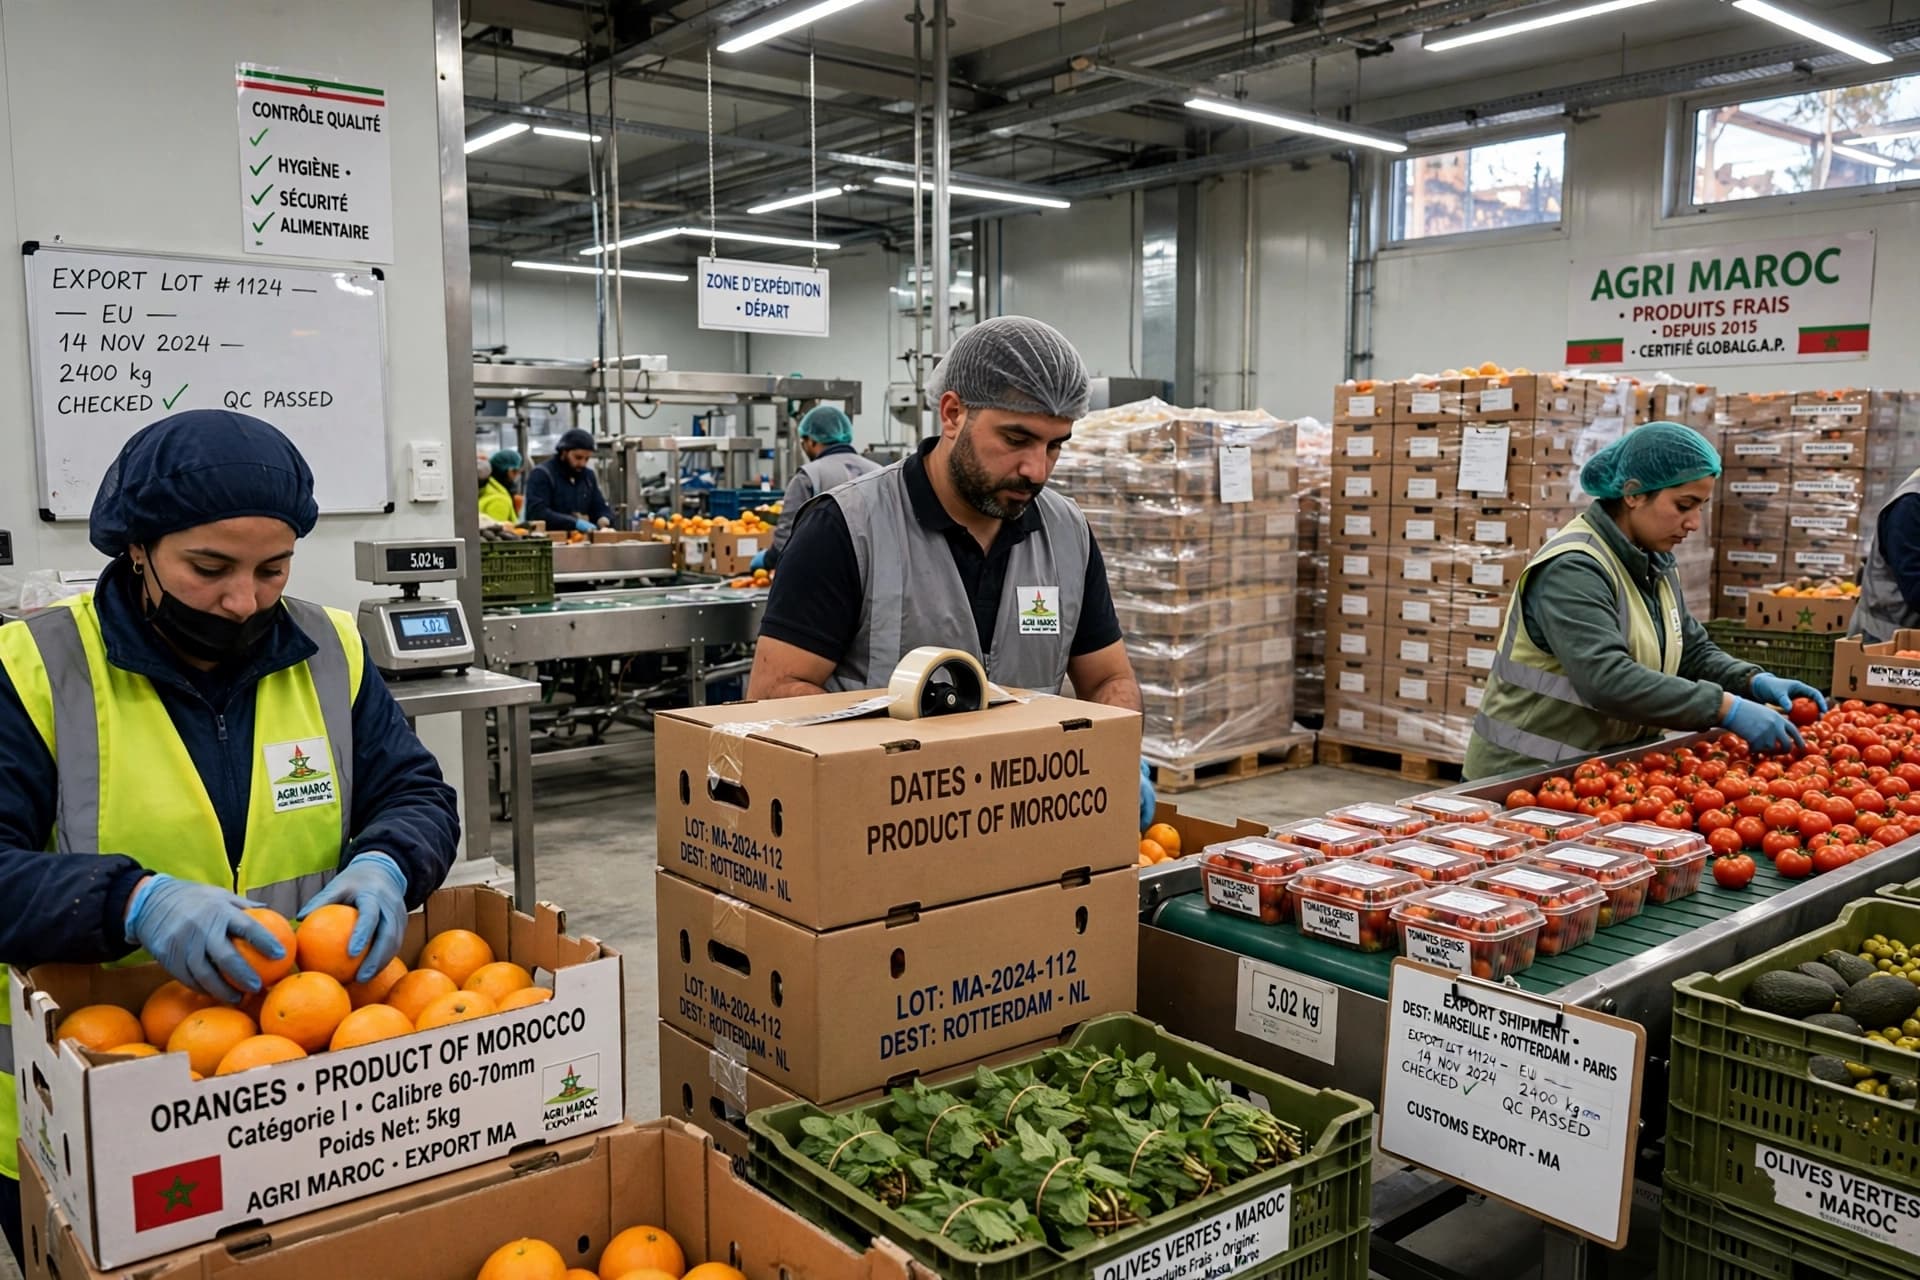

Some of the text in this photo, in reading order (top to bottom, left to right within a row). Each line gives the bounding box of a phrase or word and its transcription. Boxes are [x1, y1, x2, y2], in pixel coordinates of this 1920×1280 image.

[252, 101, 381, 133] CONTRÔLE QUALITÉ
[278, 158, 340, 178] HYGIÈNE
[280, 190, 348, 212] SÉCURITÉ
[280, 218, 369, 240] ALIMENTAIRE
[52, 268, 147, 291] EXPORT
[161, 274, 202, 293] LOT
[707, 273, 821, 297] ZONE D'EXPÉDITION
[1591, 247, 1842, 301] AGRI MAROC
[102, 306, 132, 323] EU
[745, 298, 789, 319] DÉPART
[1633, 296, 1790, 322] PRODUITS FRAIS
[1663, 320, 1757, 338] DEPUIS 2015
[59, 334, 210, 352] 14 NOV 2024
[1639, 338, 1785, 358] CERTIFIÉ GLOBALG.A.P.
[60, 362, 152, 388] 2400 kg
[58, 395, 152, 414] CHECKED
[224, 391, 333, 409] QC PASSED
[433, 554, 444, 568] kg
[277, 781, 332, 800] AGRI MAROC
[890, 749, 1090, 806] DATES MEDJOOL
[867, 786, 1108, 855] PRODUCT OF MOROCCO
[685, 816, 782, 870] LOT: MA-2024-112
[681, 842, 791, 902] DEST: ROTTERDAM NL
[684, 973, 781, 1040] LOT: MA-2024-112
[896, 950, 1076, 1020] LOT: MA-2024-112
[1268, 984, 1320, 1027] 5.02 kg
[680, 996, 790, 1072] DEST: ROTTERDAM NL
[880, 979, 1090, 1060] DEST: ROTTERDAM NL
[1403, 1000, 1617, 1081] DEST: MARSEILLE ROTTERDAM PARIS
[1443, 993, 1570, 1045] EXPORT SHIPMENT
[151, 1007, 586, 1133] ORANGES PRODUCT OF MOROCCO
[1417, 1049, 1431, 1065] 14
[1438, 1056, 1460, 1073] NOV
[1466, 1065, 1497, 1086] 2024
[1519, 1083, 1557, 1105] 2400
[227, 1057, 535, 1149] Catégorie I Calibre 60-70mm
[567, 1097, 598, 1114] MAROC
[1402, 1060, 1590, 1138] CHECKED QC PASSED
[319, 1106, 461, 1158] Poids Net: 5kg
[1407, 1100, 1560, 1171] CUSTOMS EXPORT MA
[246, 1121, 517, 1214] AGRI MAROC EXPORT MA
[1764, 1151, 1920, 1218] OLIVES VERTES
[1820, 1192, 1897, 1234] MAROC
[1103, 1192, 1285, 1280] OLIVES VERTES MAROC
[1189, 1251, 1212, 1273] Frais
